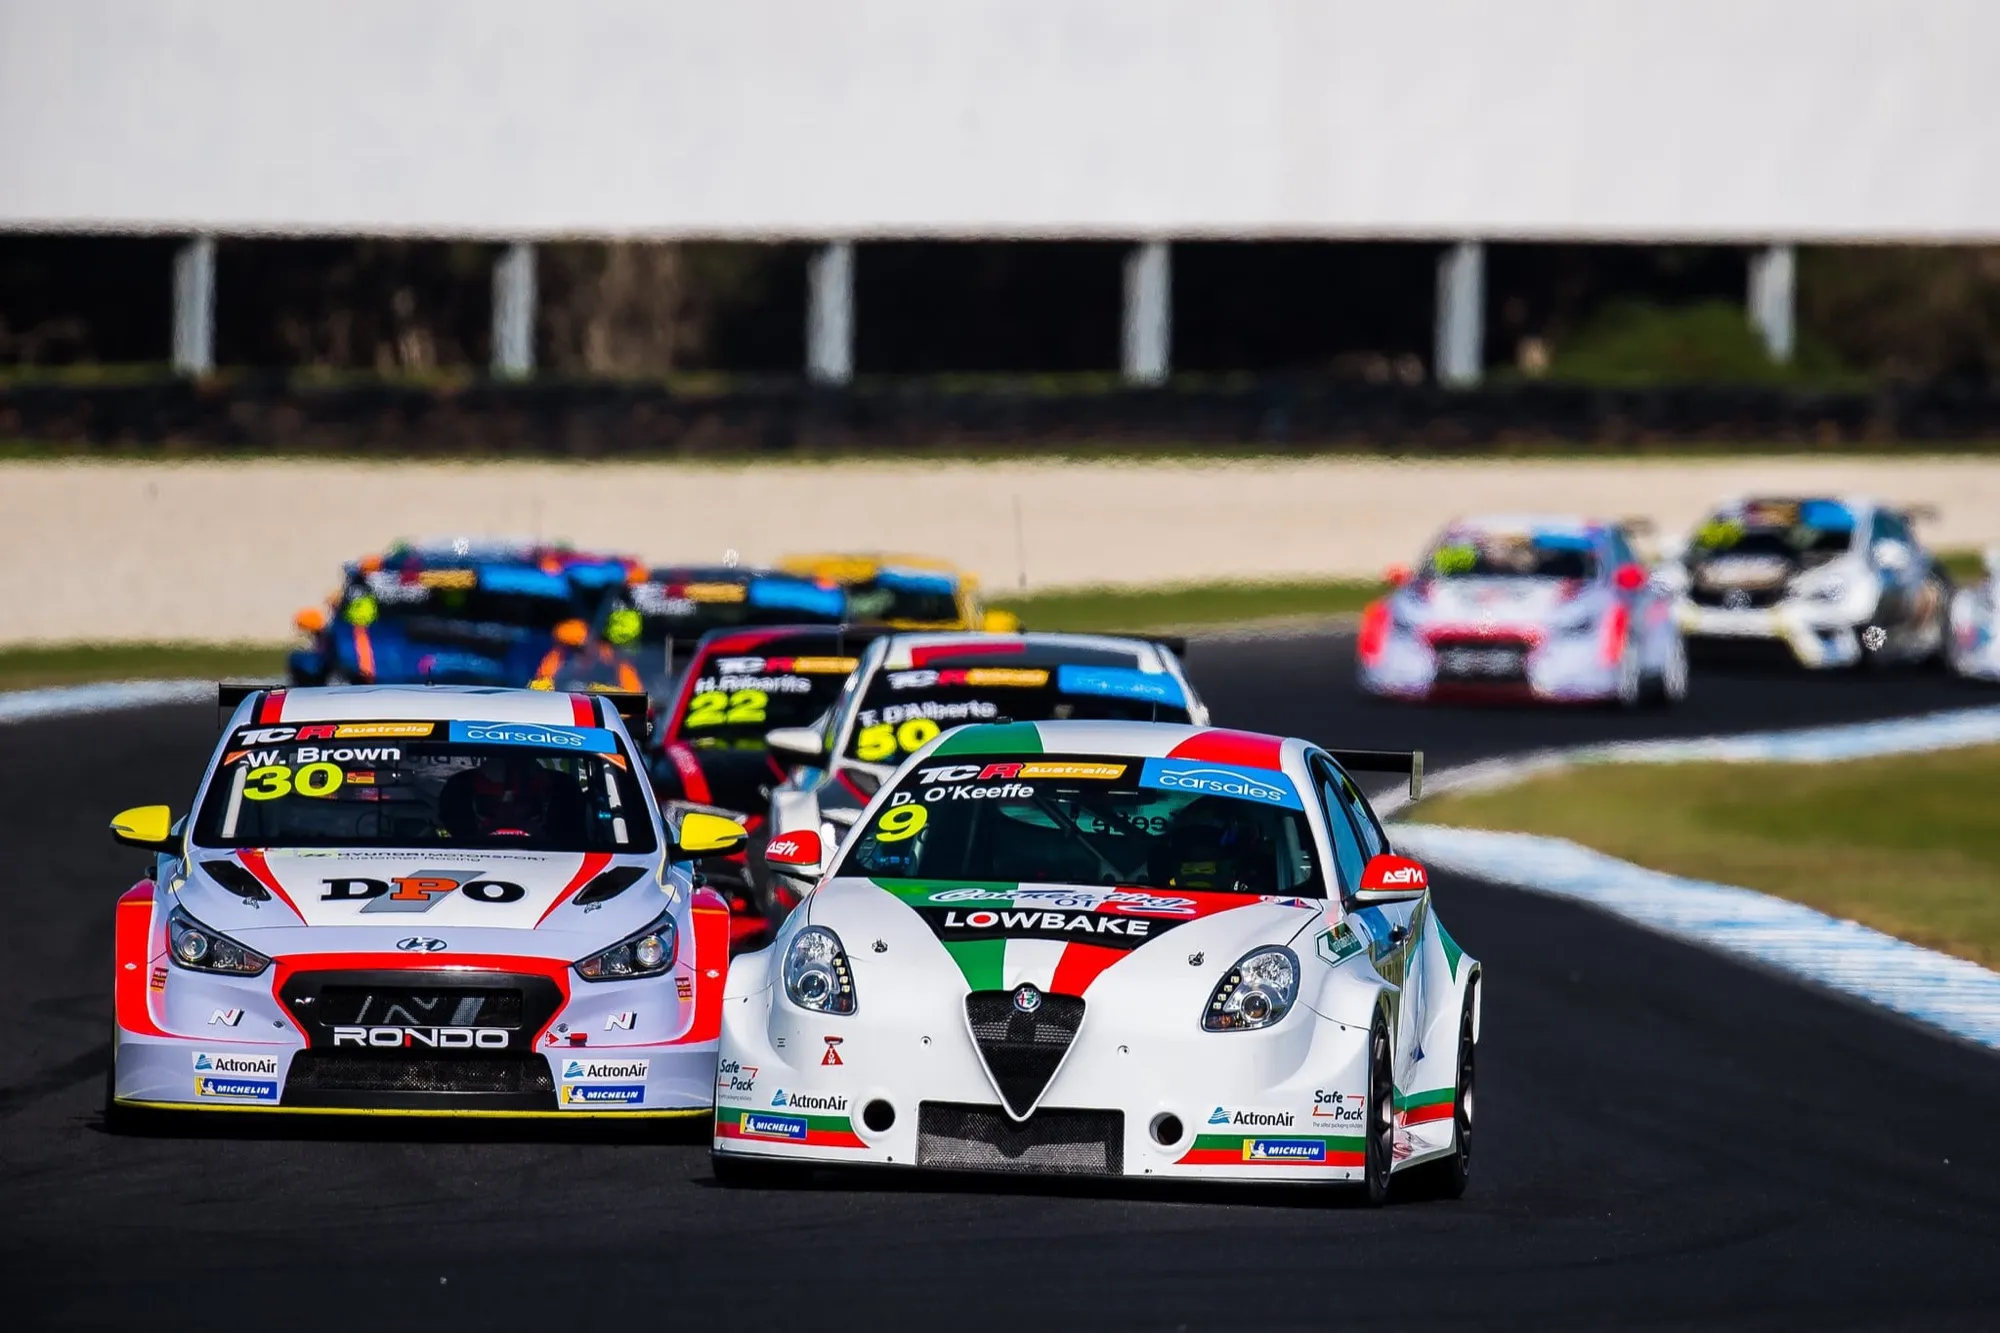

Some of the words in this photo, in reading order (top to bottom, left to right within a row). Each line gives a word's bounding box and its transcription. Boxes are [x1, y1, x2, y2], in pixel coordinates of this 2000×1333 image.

[686, 689, 768, 729] 22
[237, 725, 338, 746] TCR
[341, 724, 429, 735] Australia
[467, 729, 582, 747] carsales
[856, 718, 941, 761] 50
[247, 749, 286, 768] W.
[297, 747, 400, 763] Brown
[243, 762, 343, 800] 30
[918, 762, 1024, 784] TCR
[1025, 766, 1119, 776] Australia
[891, 791, 916, 807] D.
[924, 783, 1034, 803] O'Keeffe
[1159, 774, 1282, 802] carsales
[876, 804, 928, 842] 9
[321, 877, 526, 903] DPO
[944, 911, 1151, 937] LOWBAKE
[334, 1027, 509, 1049] RONDO
[215, 1058, 277, 1074] ActronAir
[587, 1062, 648, 1078] ActronAir
[720, 1058, 740, 1074] Safe
[217, 1085, 269, 1095] MICHELIN
[730, 1076, 755, 1091] Pack
[586, 1091, 639, 1100] MICHELIN
[789, 1093, 848, 1111] ActronAir
[1314, 1089, 1343, 1104] Safe
[1233, 1111, 1296, 1127] ActronAir
[1334, 1106, 1363, 1121] Pack
[756, 1121, 801, 1133] MICHELIN
[1268, 1146, 1320, 1155] MICHELIN
